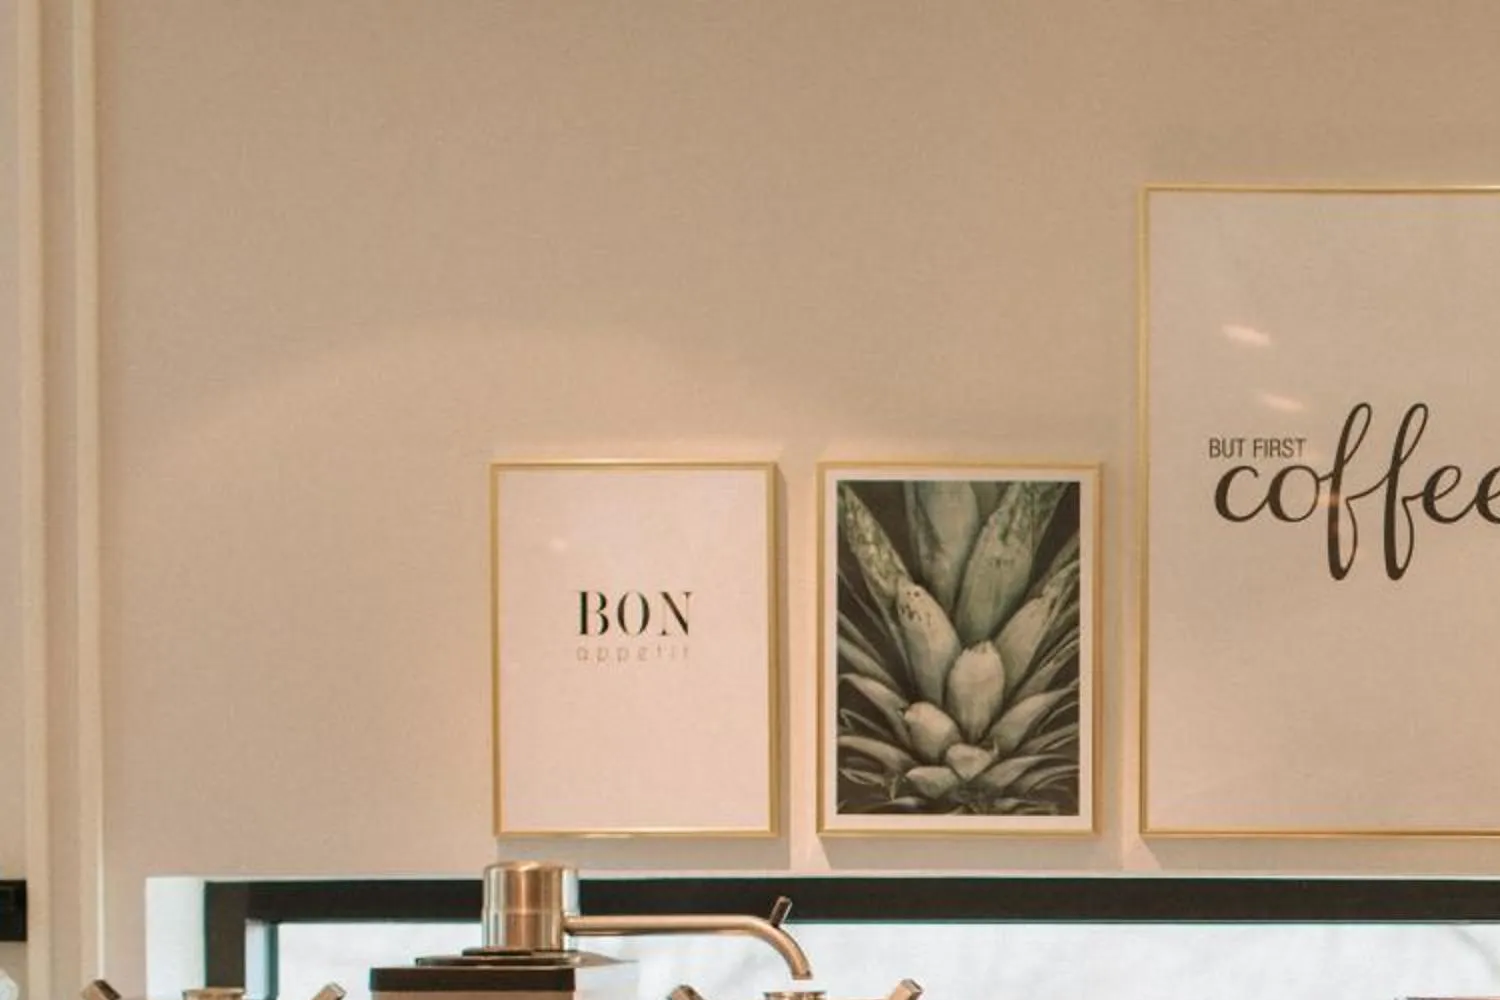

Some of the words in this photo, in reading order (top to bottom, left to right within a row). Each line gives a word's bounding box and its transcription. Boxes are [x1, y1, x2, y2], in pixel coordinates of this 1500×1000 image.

[1208, 437, 1246, 459] BUT
[1252, 437, 1308, 459] FIRST
[574, 589, 693, 637] BON
